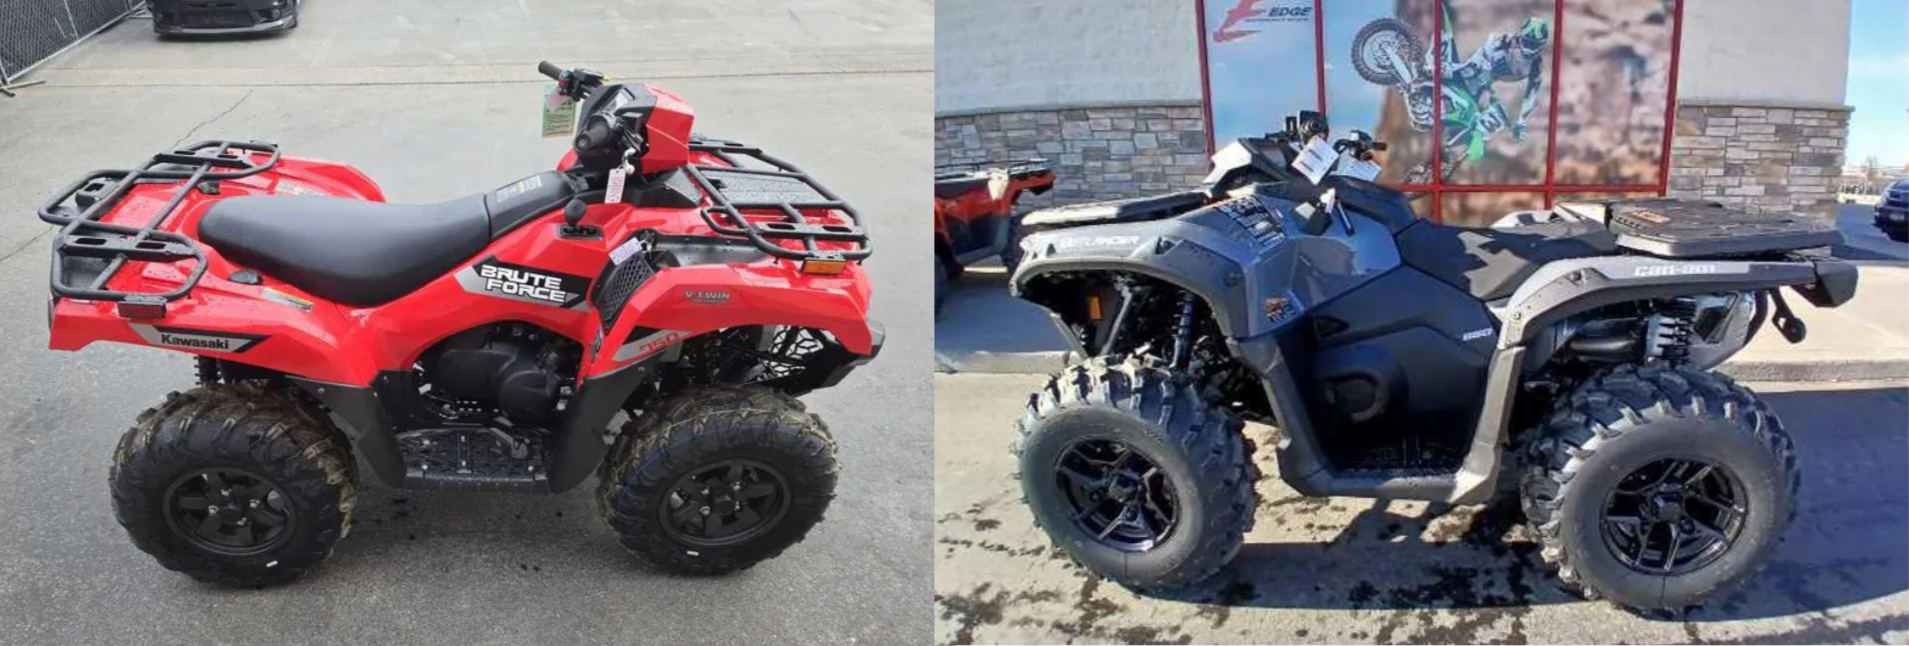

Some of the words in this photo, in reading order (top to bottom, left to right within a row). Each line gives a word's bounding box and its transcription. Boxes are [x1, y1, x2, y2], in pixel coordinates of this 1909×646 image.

[1268, 6, 1313, 17] EDGE
[481, 264, 562, 290] BRUTE
[487, 278, 567, 303] FORCE
[161, 333, 229, 349] Kawasaki
